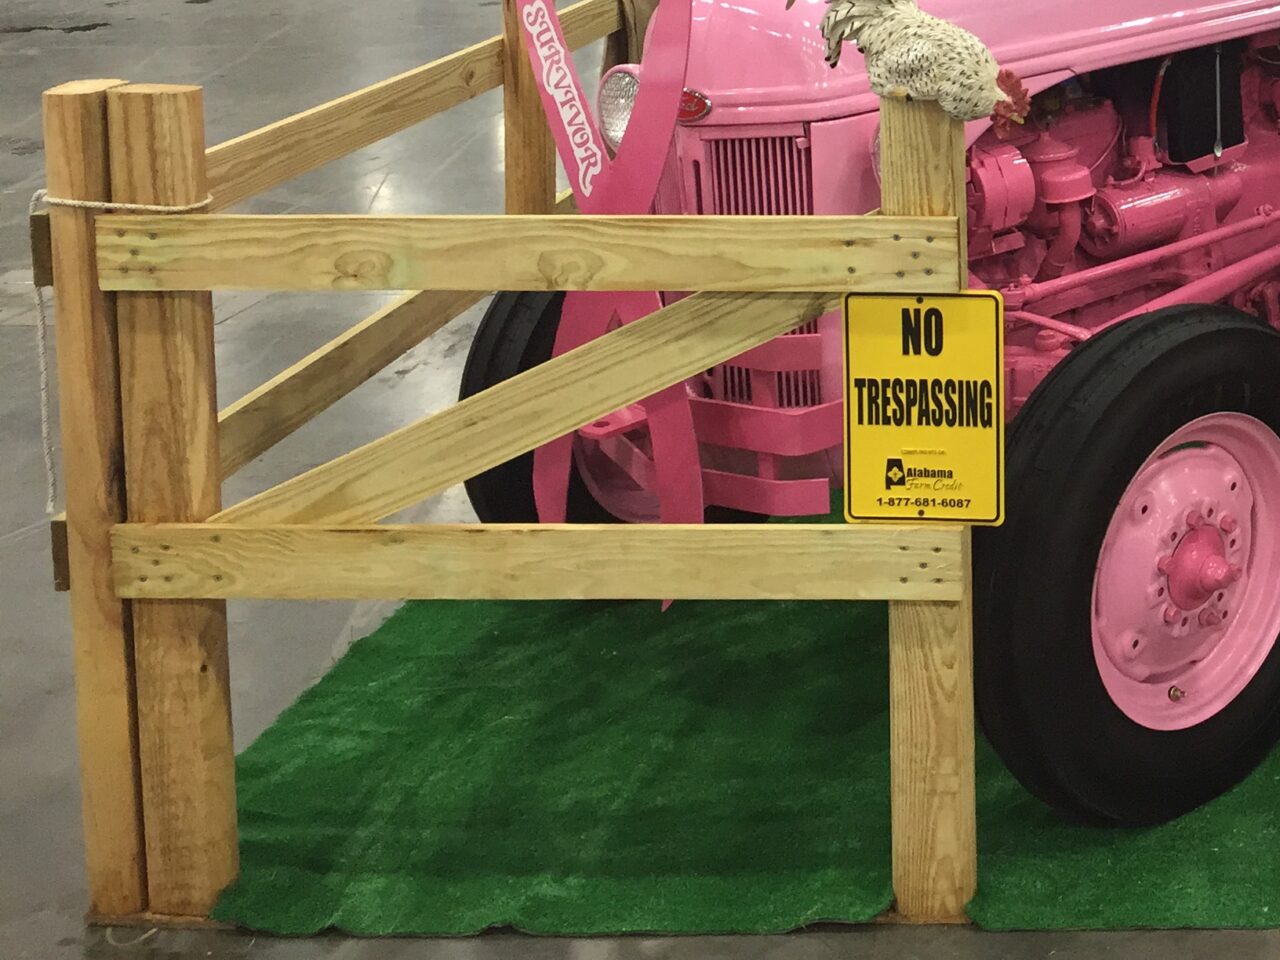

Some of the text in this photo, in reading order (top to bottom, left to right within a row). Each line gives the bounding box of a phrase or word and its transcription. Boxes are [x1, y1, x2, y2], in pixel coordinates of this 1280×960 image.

[526, 6, 599, 191] SURVIVOR
[902, 307, 943, 356] NO
[854, 377, 993, 429] TRESPASSING
[906, 467, 953, 479] Alabama
[906, 477, 963, 491] Farm Credit
[876, 497, 971, 509] 1-877-681-6087
